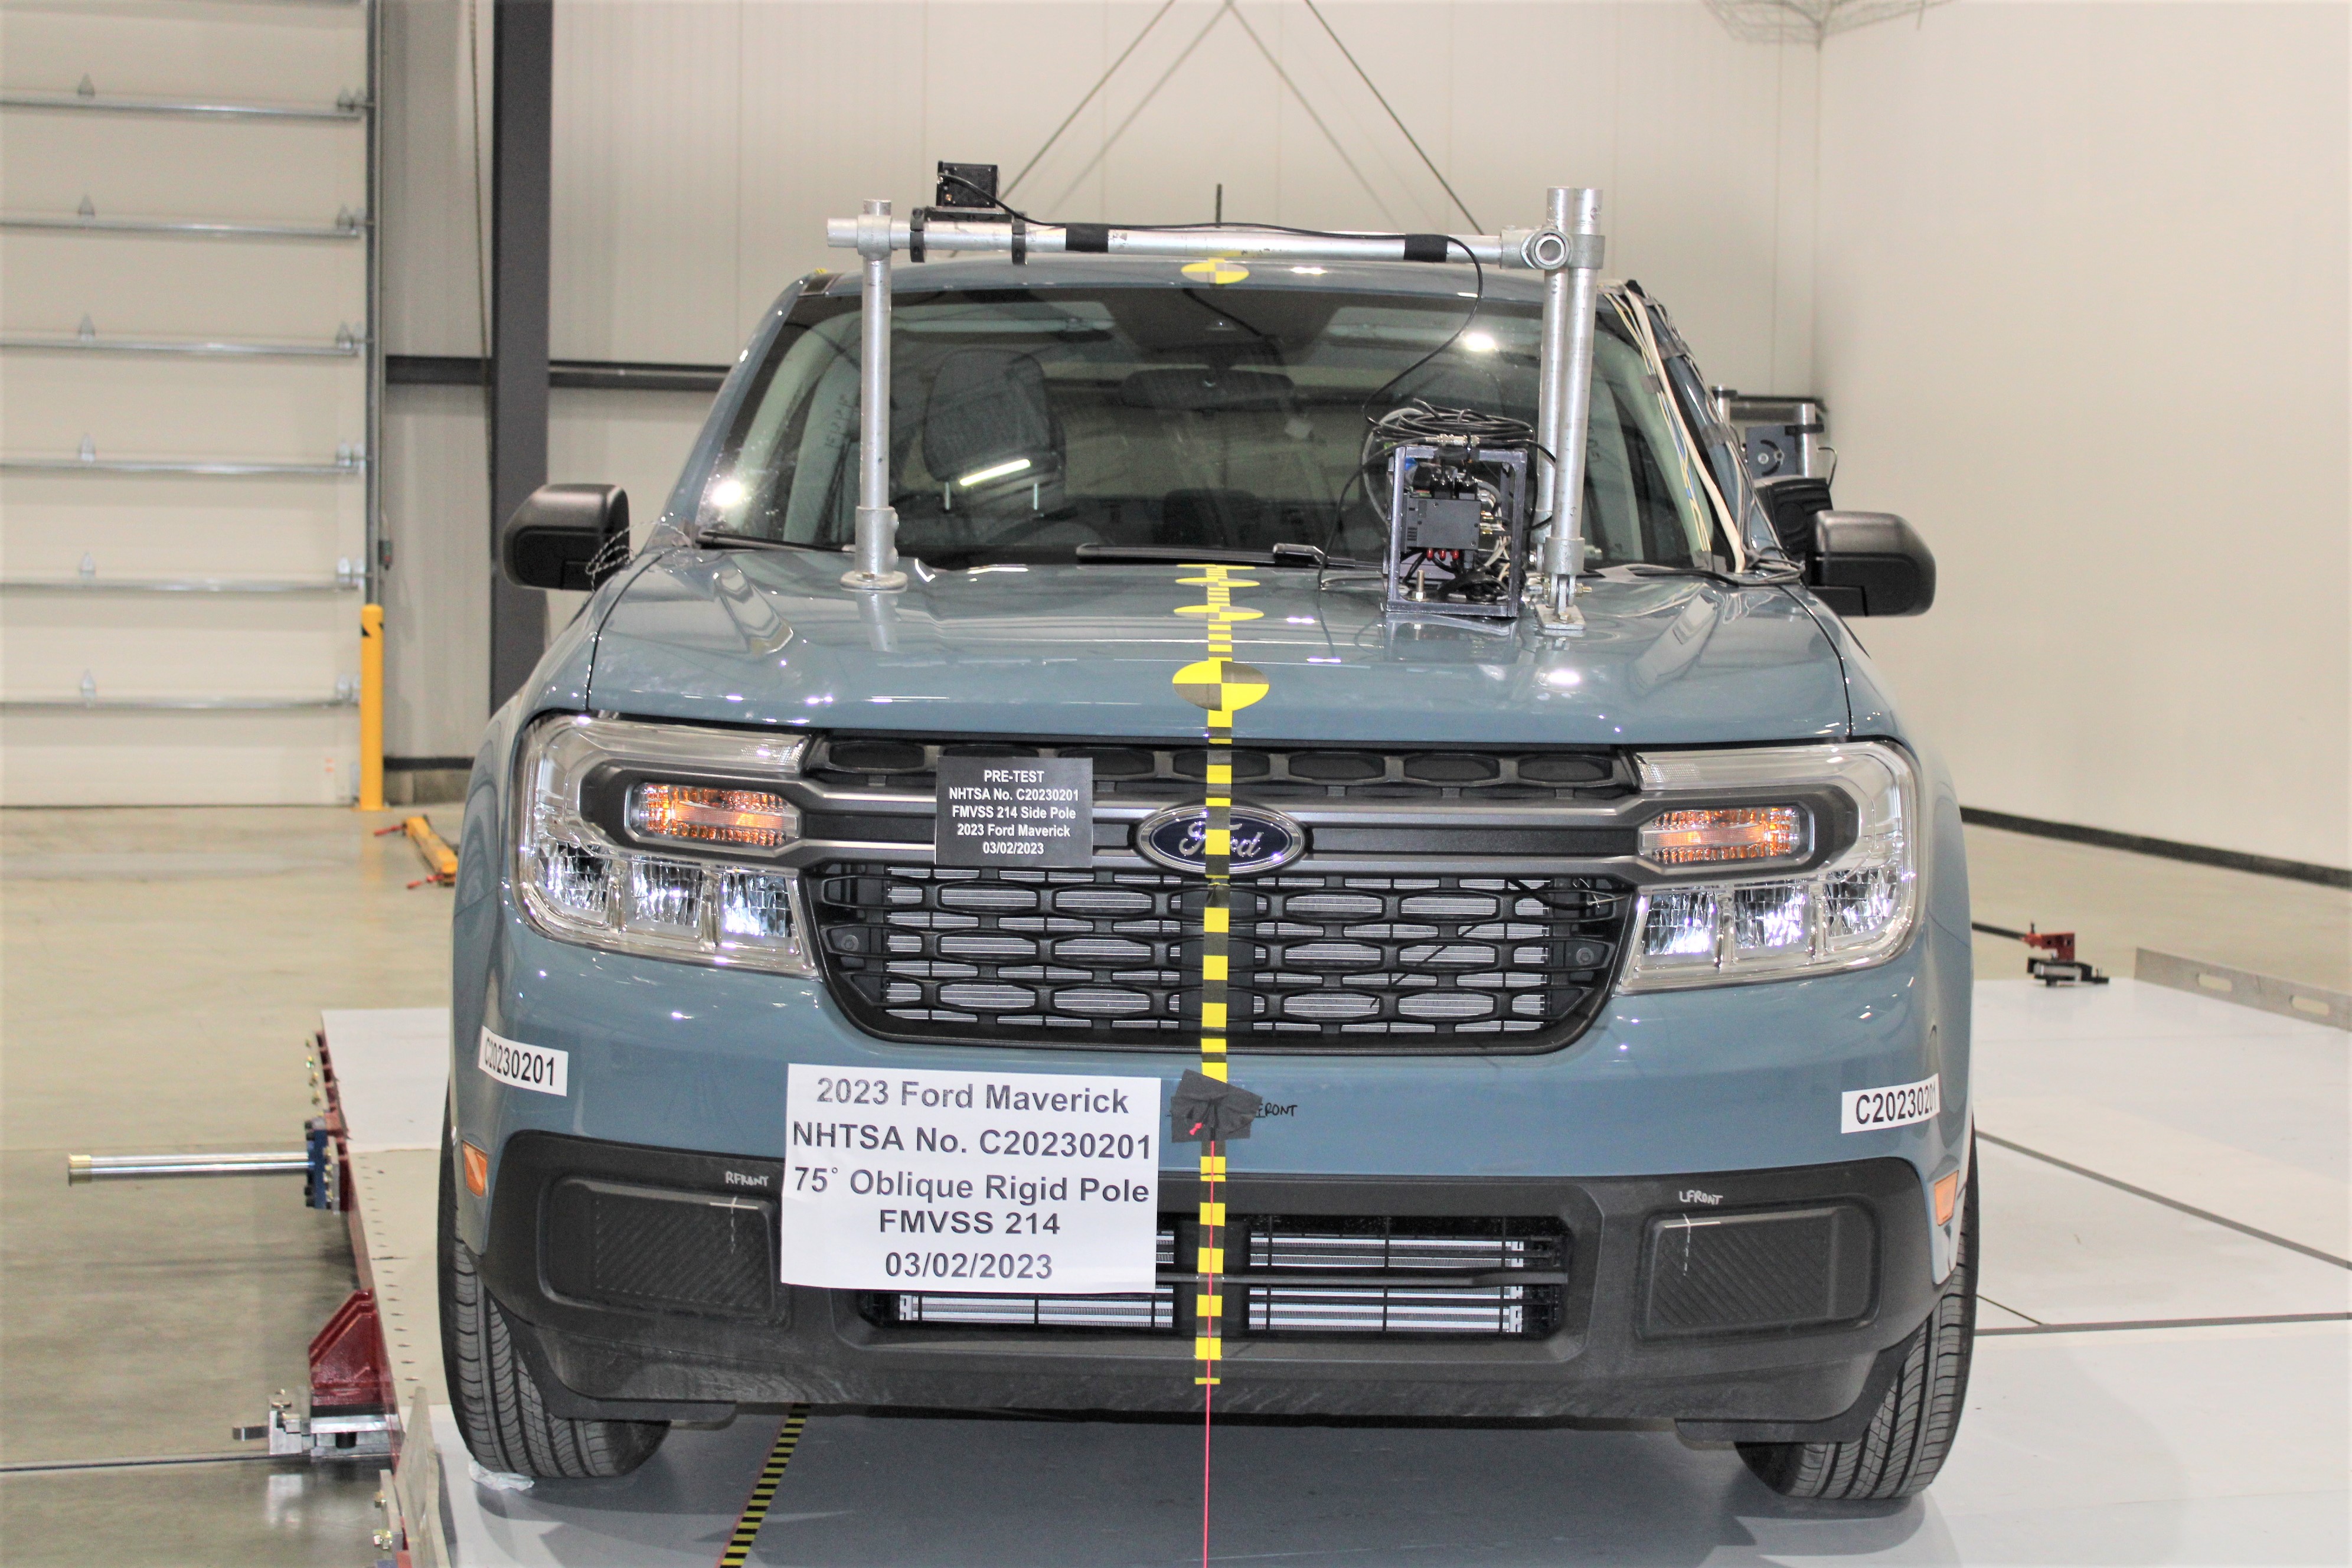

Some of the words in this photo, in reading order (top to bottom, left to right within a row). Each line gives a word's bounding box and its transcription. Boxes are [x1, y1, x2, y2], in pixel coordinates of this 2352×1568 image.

[984, 769, 1045, 783] PRE-TEST
[949, 787, 991, 801] NHTSA
[994, 788, 1013, 801] No.
[1016, 788, 1079, 802] C20230201
[952, 805, 994, 818] FMVSS
[997, 806, 1018, 818] 214
[1020, 806, 1047, 819] Side
[1050, 806, 1076, 819] Pole
[957, 823, 985, 836] 2023
[988, 823, 1015, 837] Ford
[1018, 824, 1071, 837] Maverick
[982, 841, 1044, 855] 03/02/2023
[484, 1037, 555, 1086] C20230201
[817, 1077, 888, 1105] 2023
[901, 1081, 973, 1108] Ford
[986, 1084, 1129, 1113] Maverick
[1856, 1080, 1937, 1125] C20230201
[793, 1121, 904, 1151] NHTSA
[916, 1126, 966, 1153] No.
[979, 1129, 1149, 1159] C20230201
[850, 1169, 973, 1204] Oblique
[986, 1174, 1067, 1206] Rigid
[1080, 1178, 1149, 1203] Pole
[880, 1209, 994, 1234] FMVSS
[1005, 1212, 1060, 1234] 214
[886, 1252, 1052, 1279] 03/02/2023
